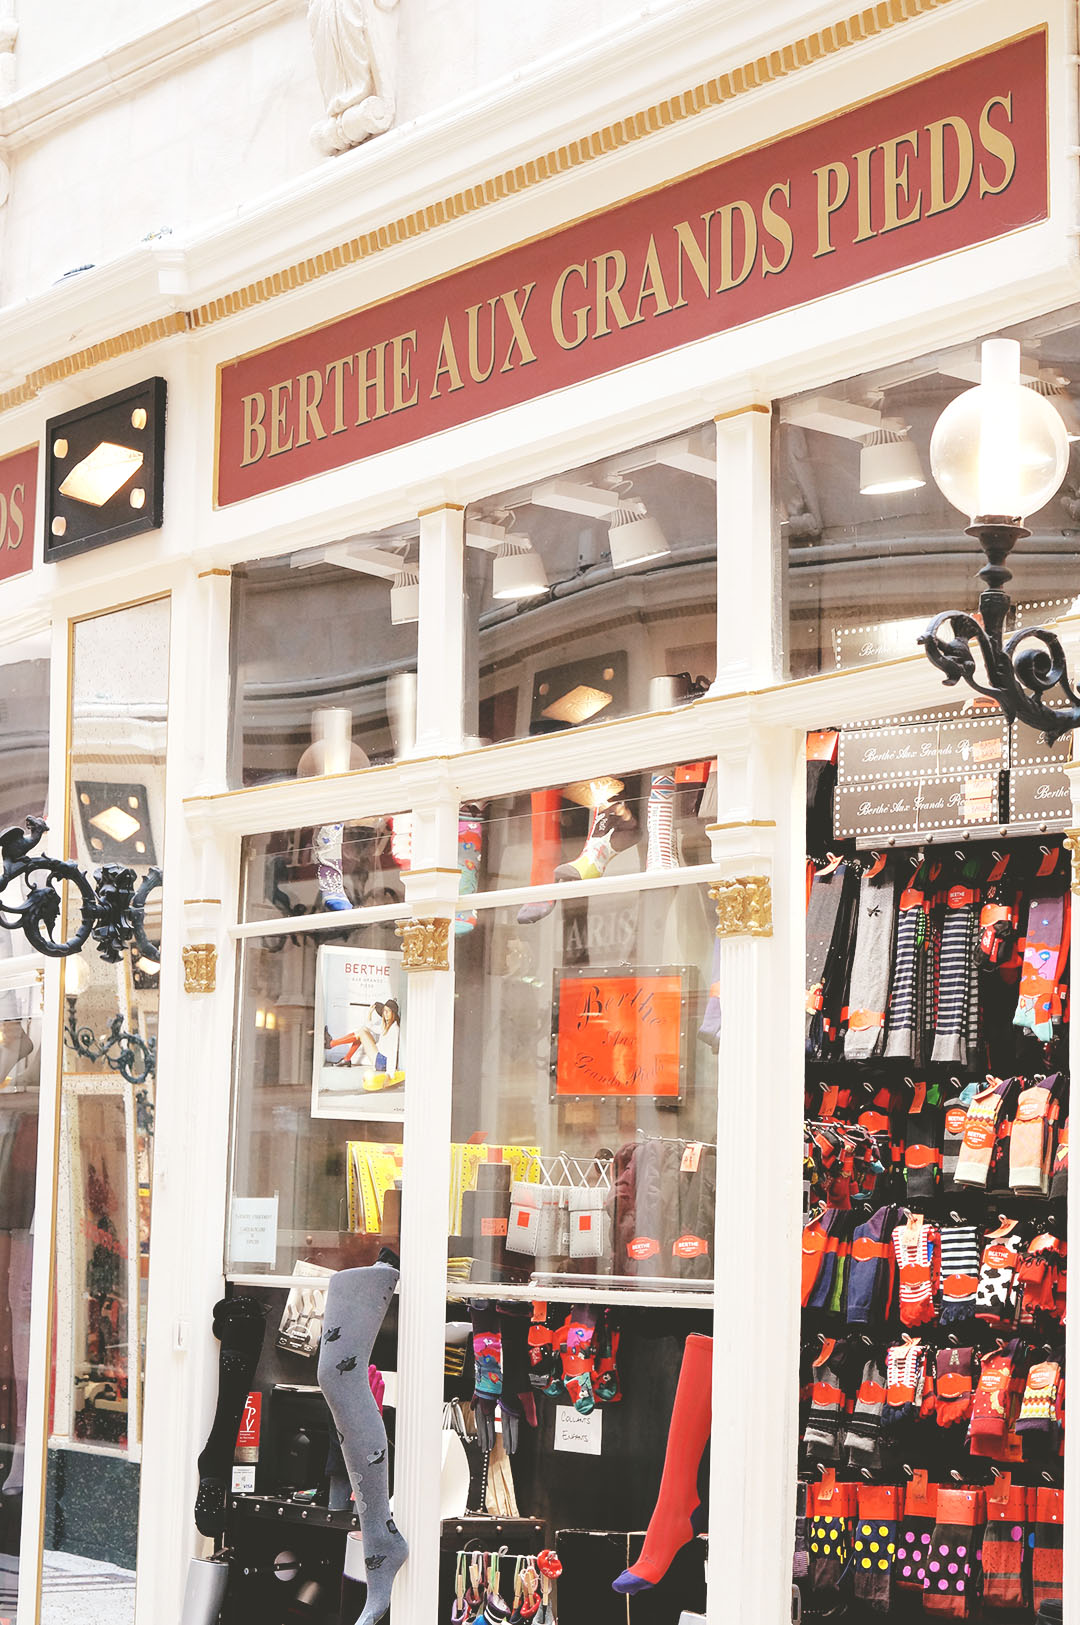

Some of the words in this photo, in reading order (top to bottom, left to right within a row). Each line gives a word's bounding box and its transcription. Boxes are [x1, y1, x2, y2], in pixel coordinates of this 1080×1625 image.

[240, 329, 419, 467] BERTHE
[429, 282, 537, 399] AUX
[551, 179, 794, 350] GRANDS
[812, 91, 1017, 258] PIEDS
[920, 742, 953, 759] Grands
[913, 796, 944, 811] Grands
[344, 963, 390, 976] BERTHE
